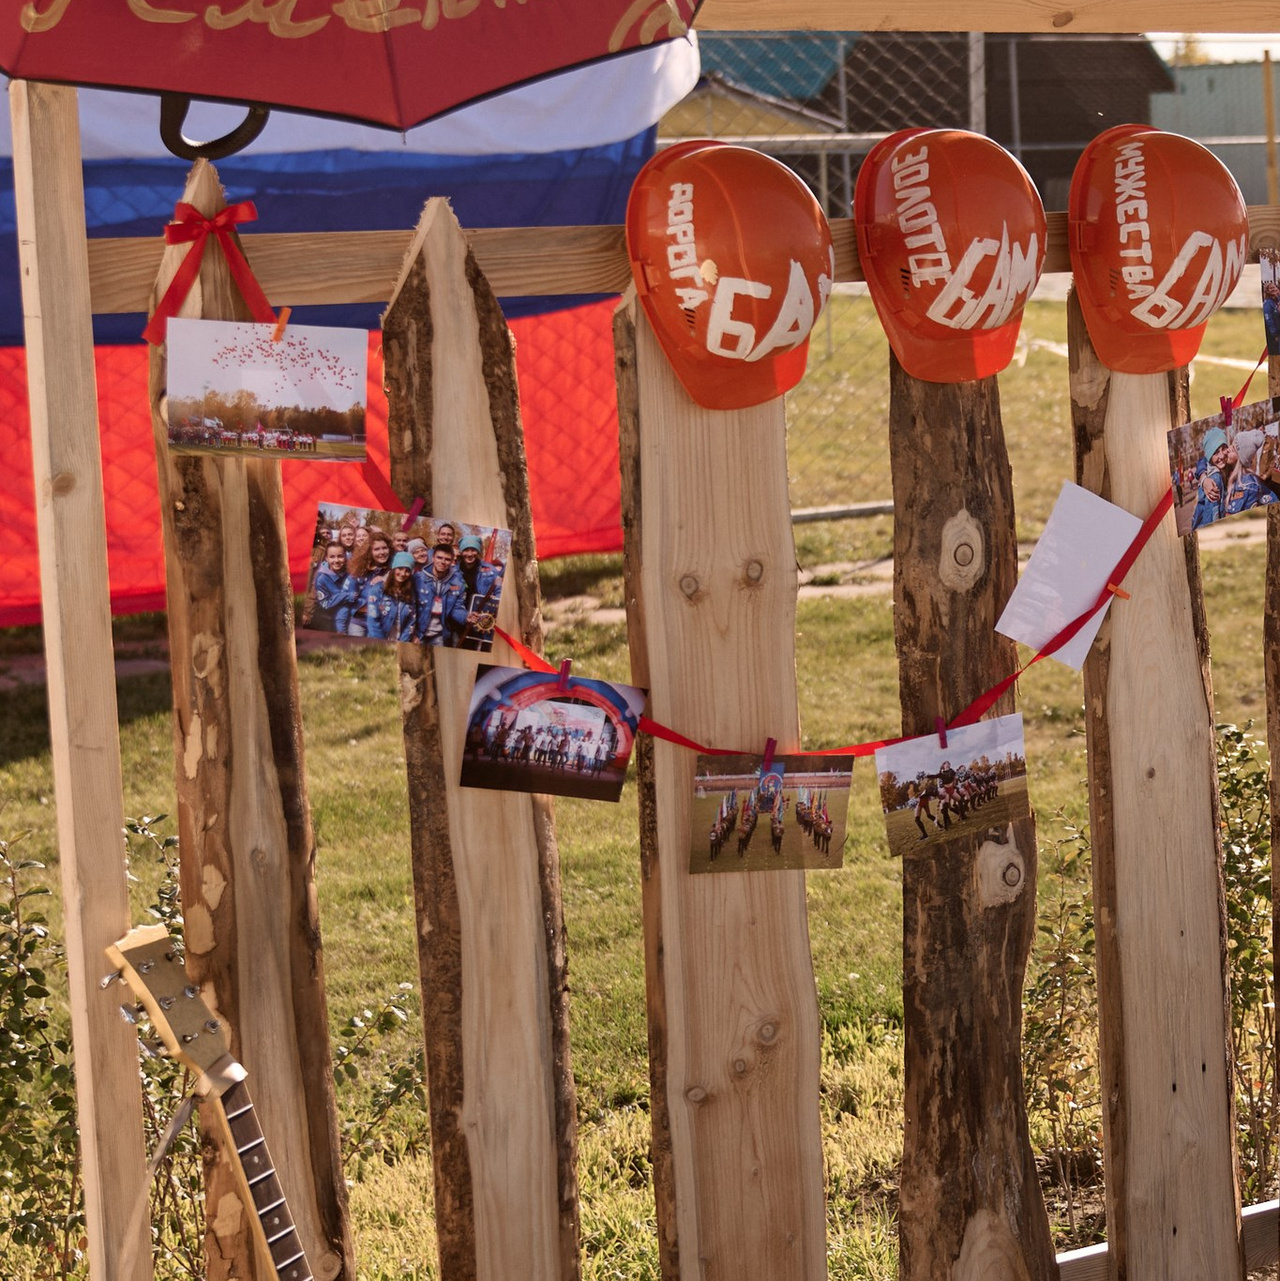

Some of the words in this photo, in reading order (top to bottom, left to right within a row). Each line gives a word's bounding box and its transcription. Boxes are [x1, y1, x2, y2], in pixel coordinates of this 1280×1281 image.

[666, 182, 709, 311] ДОРОГА
[891, 145, 953, 288] ЗОЛОТОЕ
[926, 220, 1039, 330] БАМ
[1114, 141, 1156, 300] МУЖЕСТВА
[1130, 230, 1246, 330] БАМ
